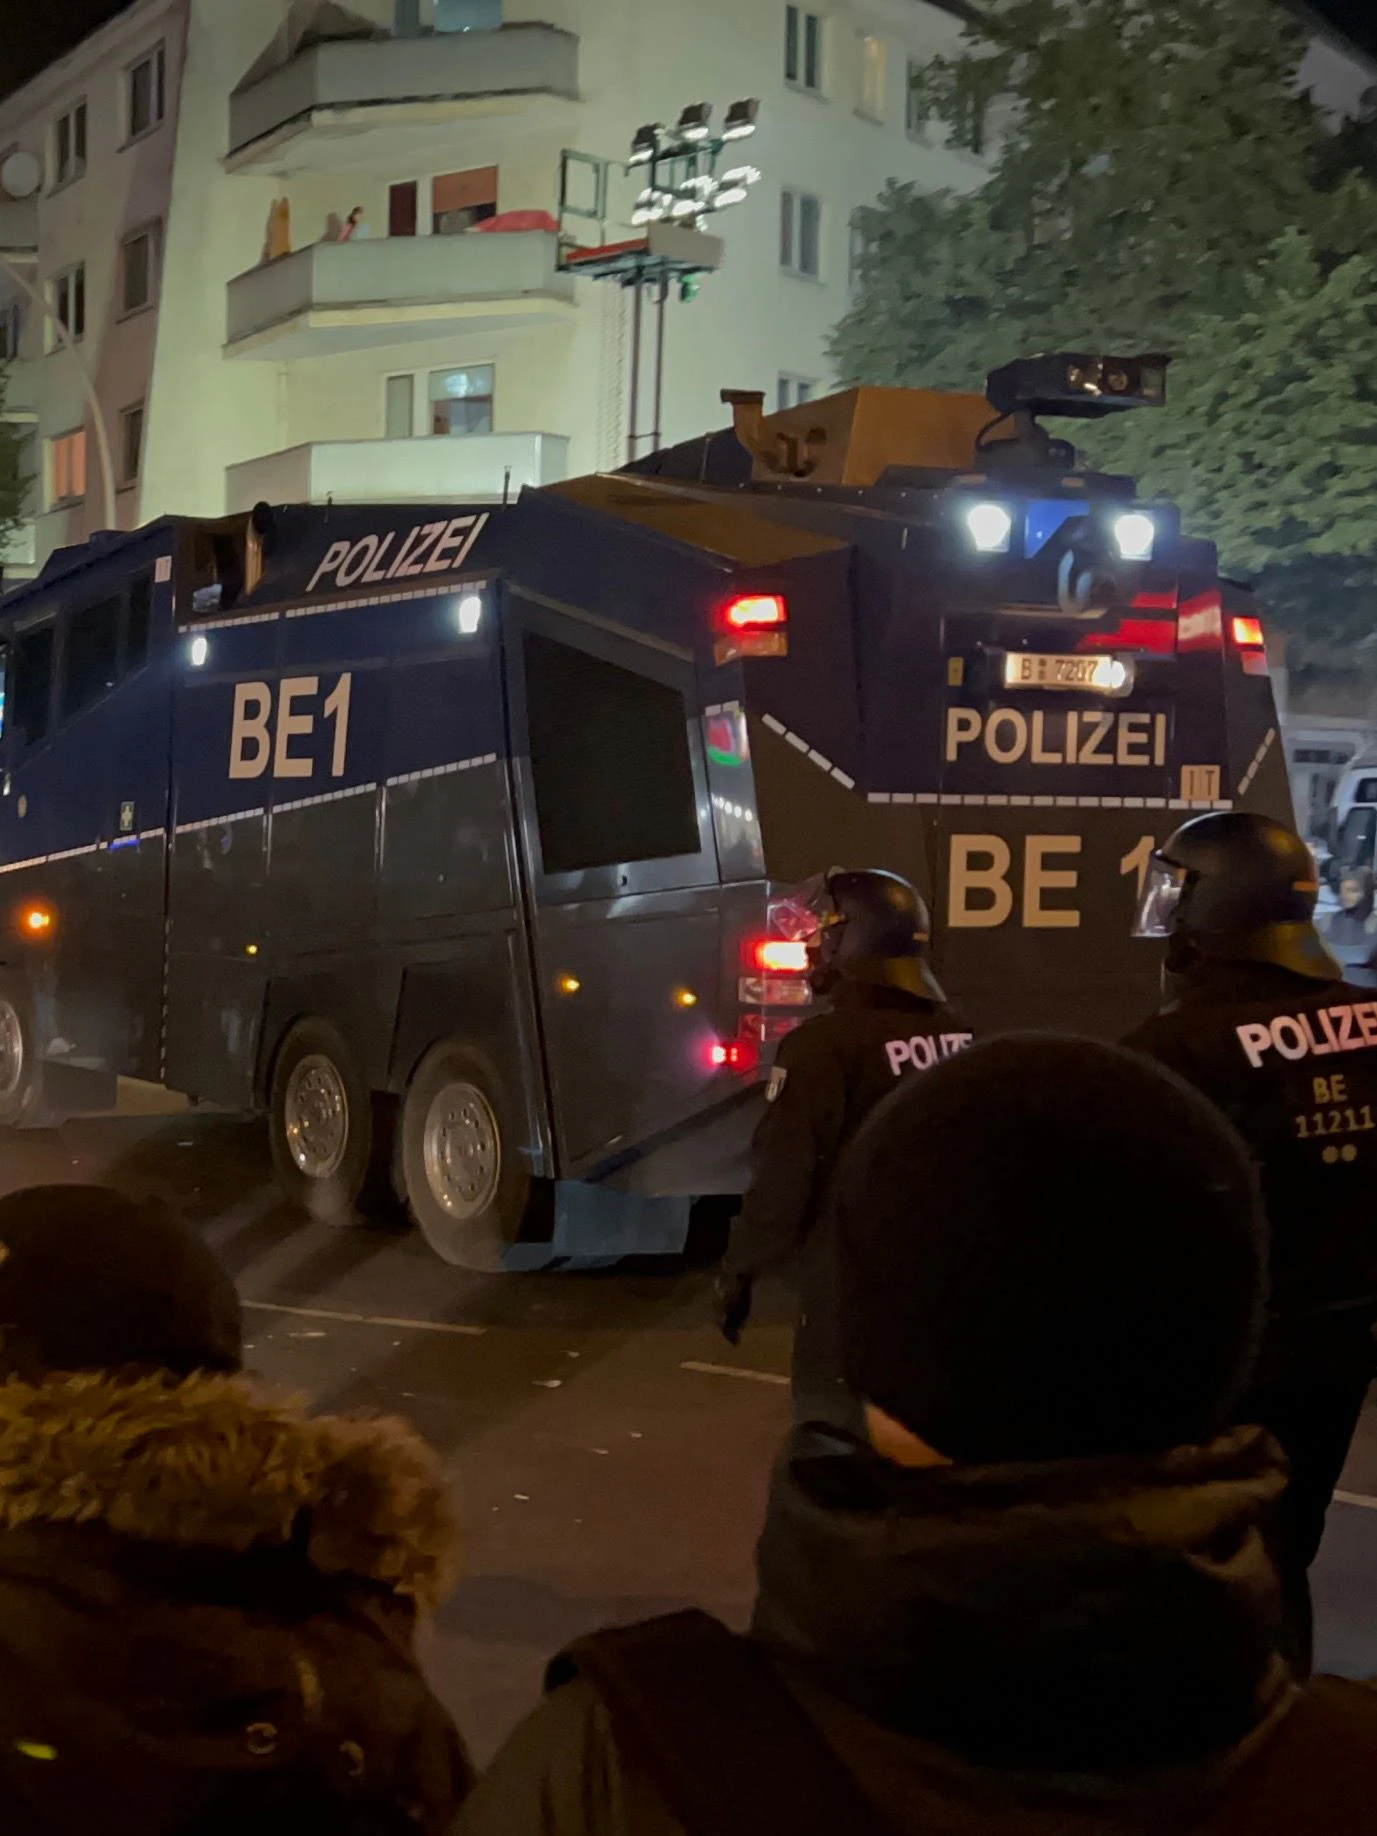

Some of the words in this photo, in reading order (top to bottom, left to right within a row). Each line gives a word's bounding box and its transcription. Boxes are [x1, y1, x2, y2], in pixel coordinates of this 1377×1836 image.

[305, 512, 490, 592] POLIZEI
[229, 672, 351, 779] BE1
[946, 708, 1166, 766] POLIZEI
[948, 834, 1082, 928] BE
[1236, 1001, 1377, 1068] POLIZE
[1295, 1105, 1376, 1138] 11211
[1313, 1074, 1347, 1104] BE
